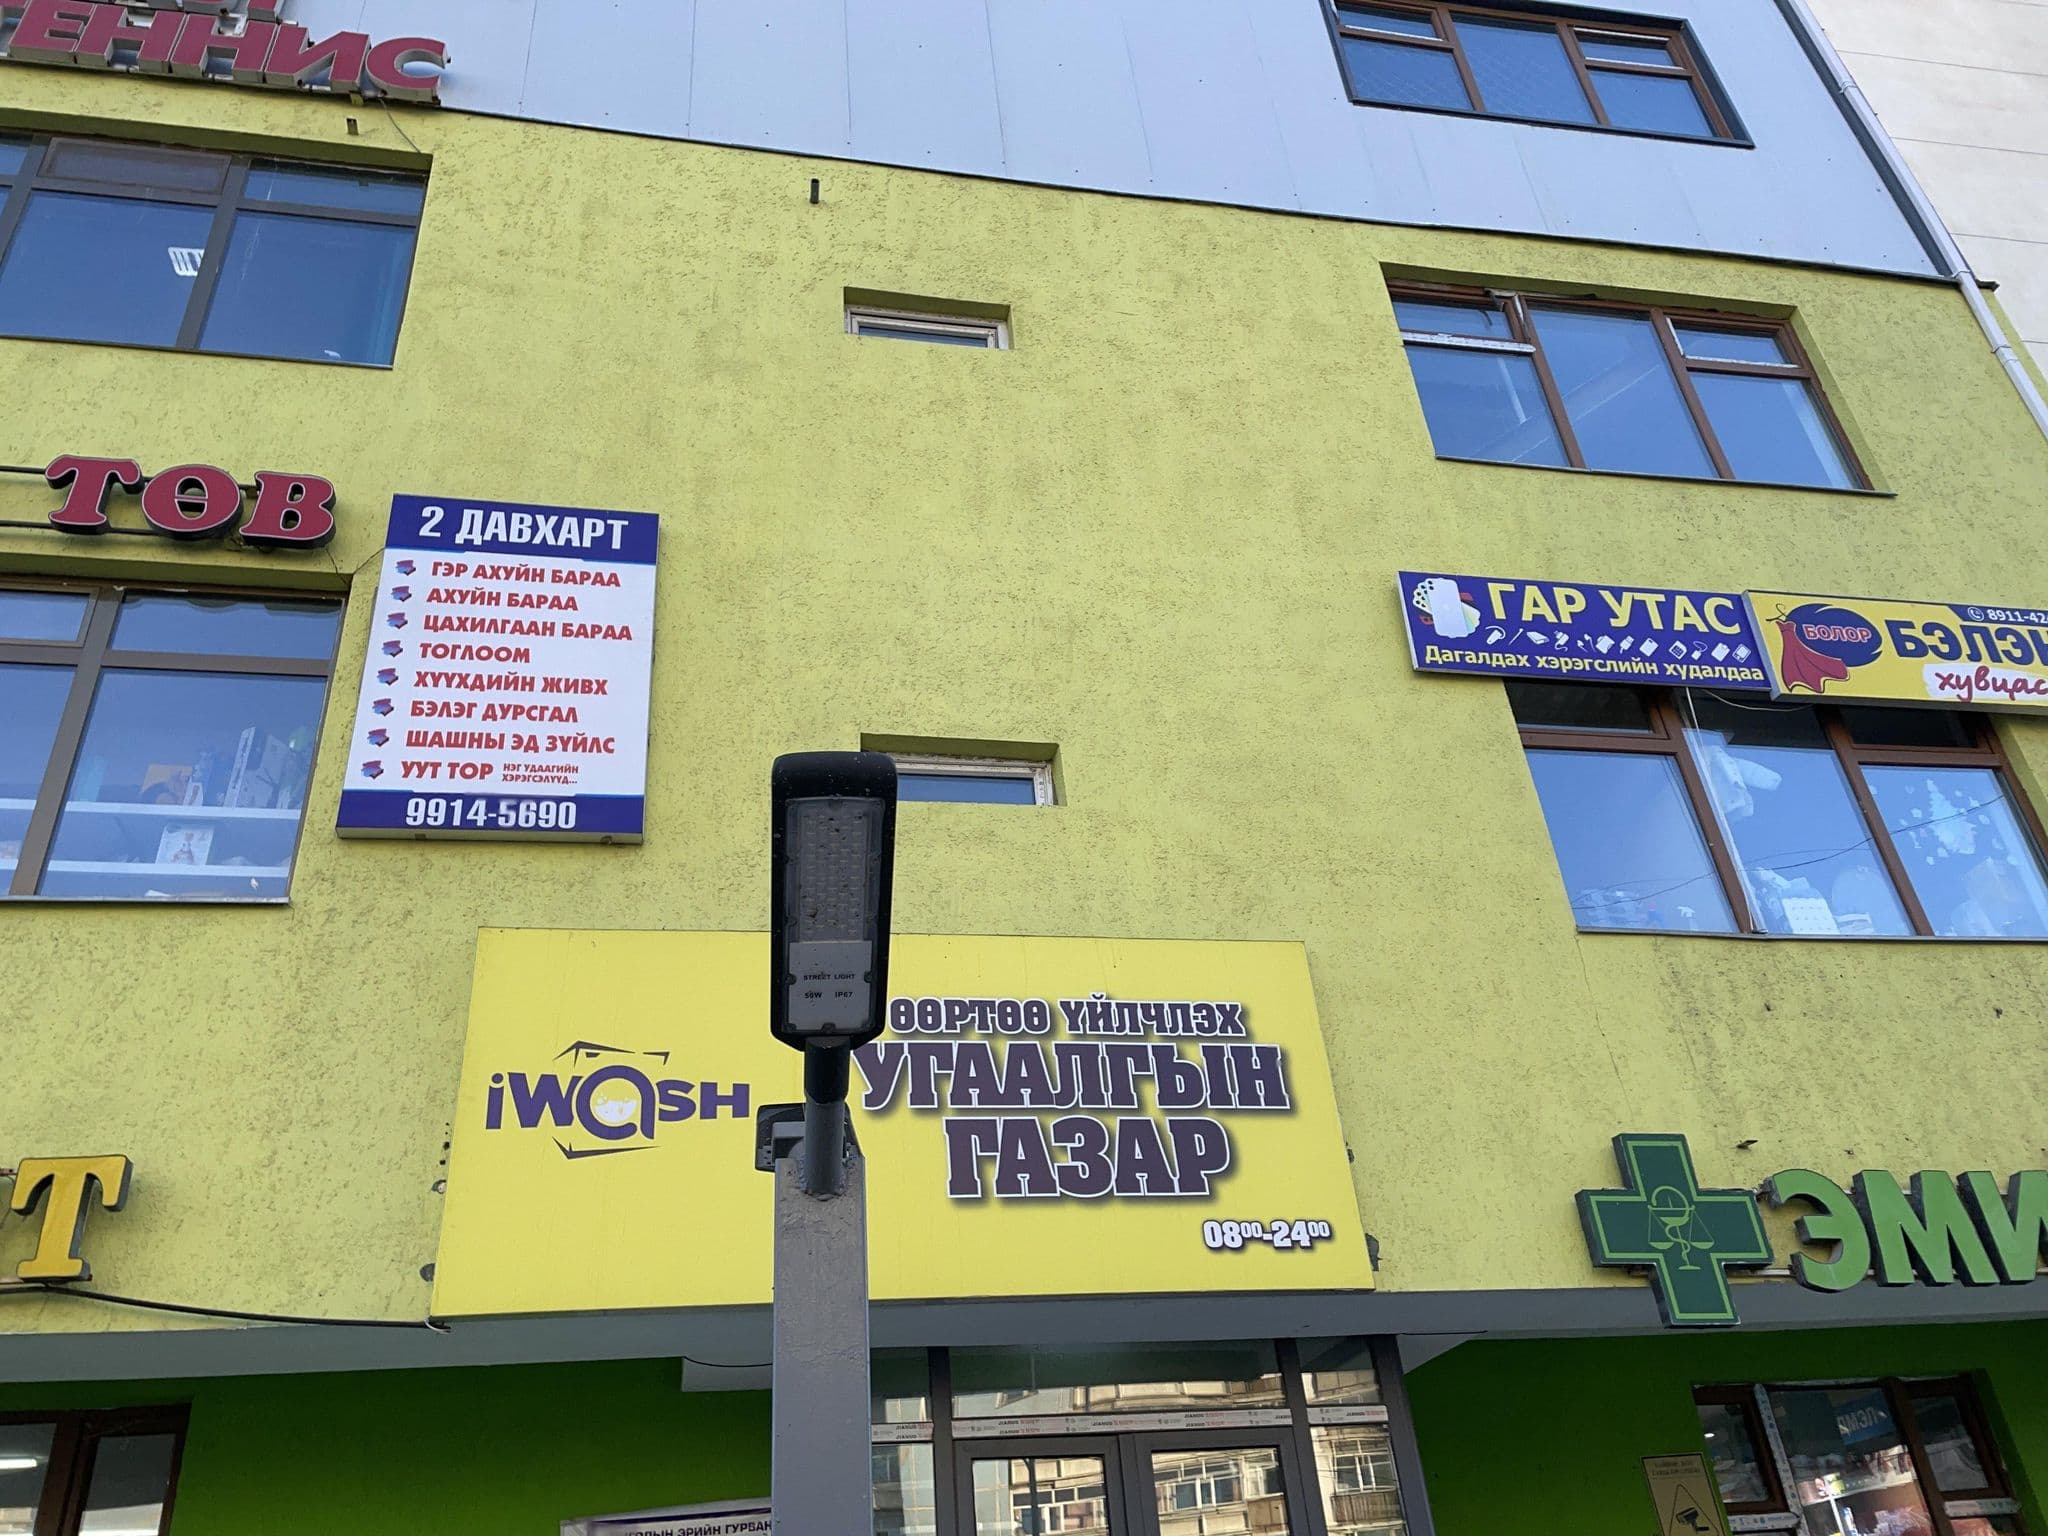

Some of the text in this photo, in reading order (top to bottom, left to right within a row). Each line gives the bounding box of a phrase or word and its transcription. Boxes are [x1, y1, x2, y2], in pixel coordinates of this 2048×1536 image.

[46, 455, 337, 547] ТӨВ
[418, 505, 629, 550] 2 ДАВХАРТ
[431, 561, 621, 587] ГЭР АХУЙН БАРАА
[426, 586, 579, 611] АХУЙН БАРАА
[1487, 582, 1741, 634] ГАР УТАС
[423, 614, 633, 641] ЦАХИЛГААН БАРАА
[1986, 609, 2048, 624] 8911-42
[1802, 624, 1873, 643] БОЛОР
[419, 642, 531, 663] ТОГЛООМ
[1425, 645, 1765, 682] Дагалдах хэрэгслийн худалдаа
[413, 671, 609, 696] ХҮҮХДИЙН ЖИВХ
[410, 700, 579, 723] БЭЛЭГ ДУРСГАЛ
[406, 730, 615, 754] ШАШНЫ ЭД ЗҮЙЛС
[401, 761, 579, 780] УУТ ТОР НЭГ УДААГИЙН
[405, 797, 577, 829] 9914-5690
[803, 973, 856, 981] STREET LIGHT
[890, 992, 1246, 1036] ӨӨРТӨӨ ҮЙЛЧЛЭХ
[851, 1040, 1290, 1110] УГААЛГЫН
[943, 1115, 1231, 1198] ГАЗАР
